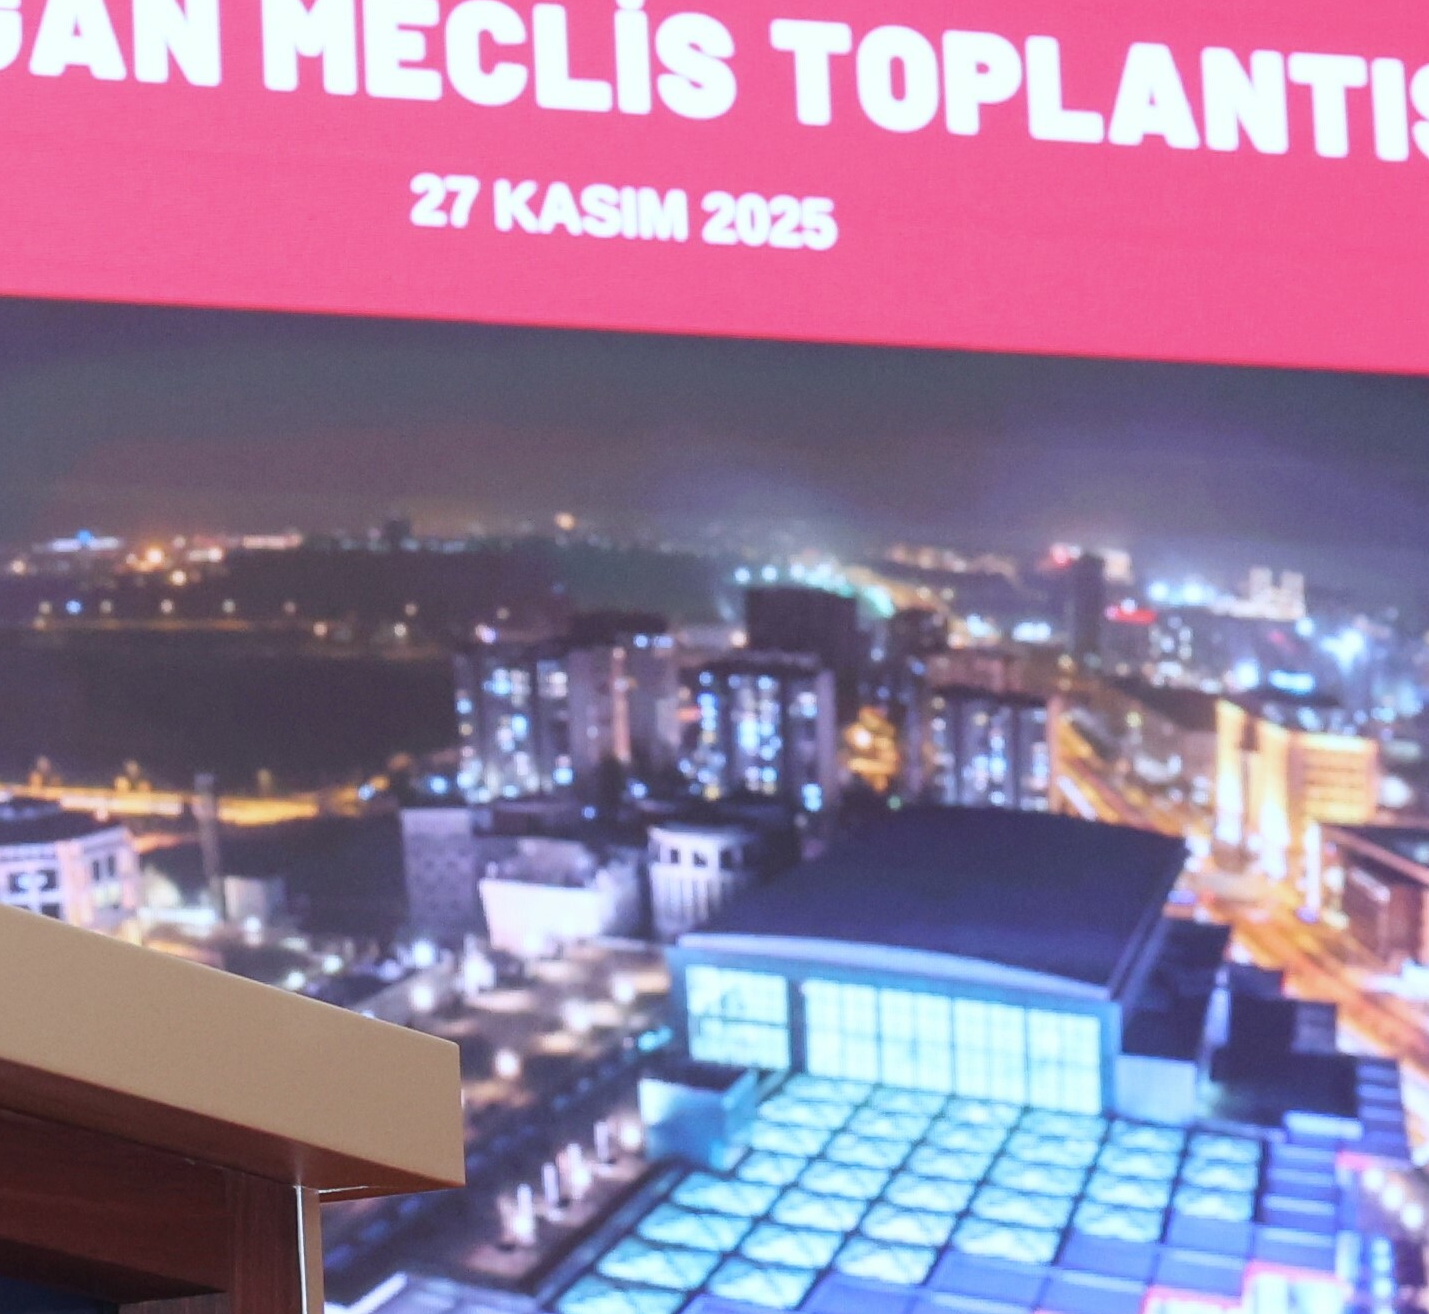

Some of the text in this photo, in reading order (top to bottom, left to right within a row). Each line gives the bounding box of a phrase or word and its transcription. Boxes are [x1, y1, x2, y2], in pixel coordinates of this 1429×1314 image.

[410, 172, 838, 251] 27 KASIM 2025
